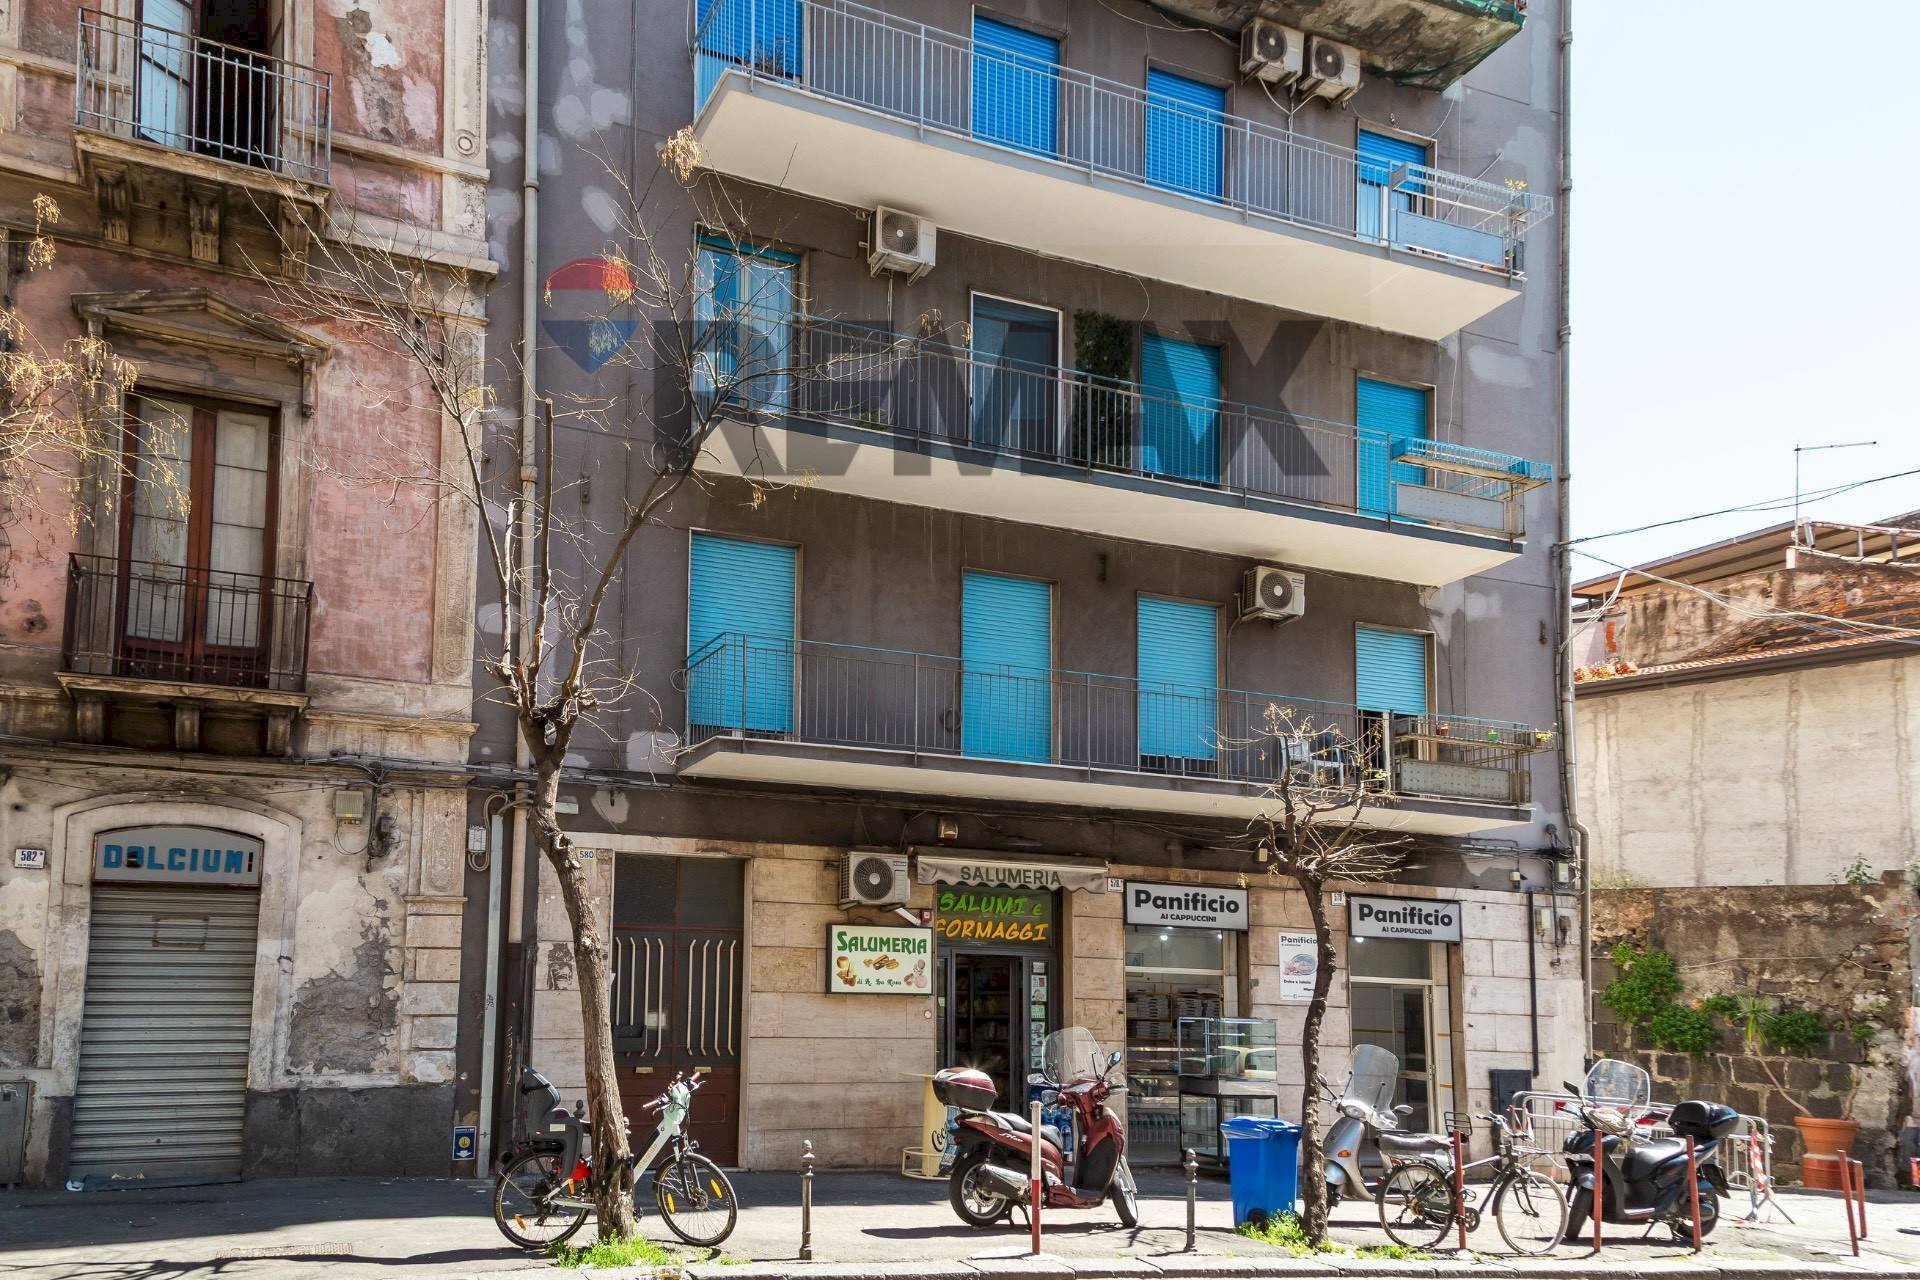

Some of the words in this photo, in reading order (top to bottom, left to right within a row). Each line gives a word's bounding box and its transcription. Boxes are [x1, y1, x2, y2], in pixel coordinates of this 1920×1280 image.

[21, 851, 37, 861] 582
[580, 851, 594, 859] 580
[960, 866, 1062, 885] SALUMERIA
[940, 893, 1029, 916] SALUMI
[1134, 889, 1240, 913] Panificio
[1170, 914, 1217, 922] CAPPUCCINI
[1358, 904, 1453, 927] Panificio
[1390, 926, 1433, 935] CAPPUCCINI
